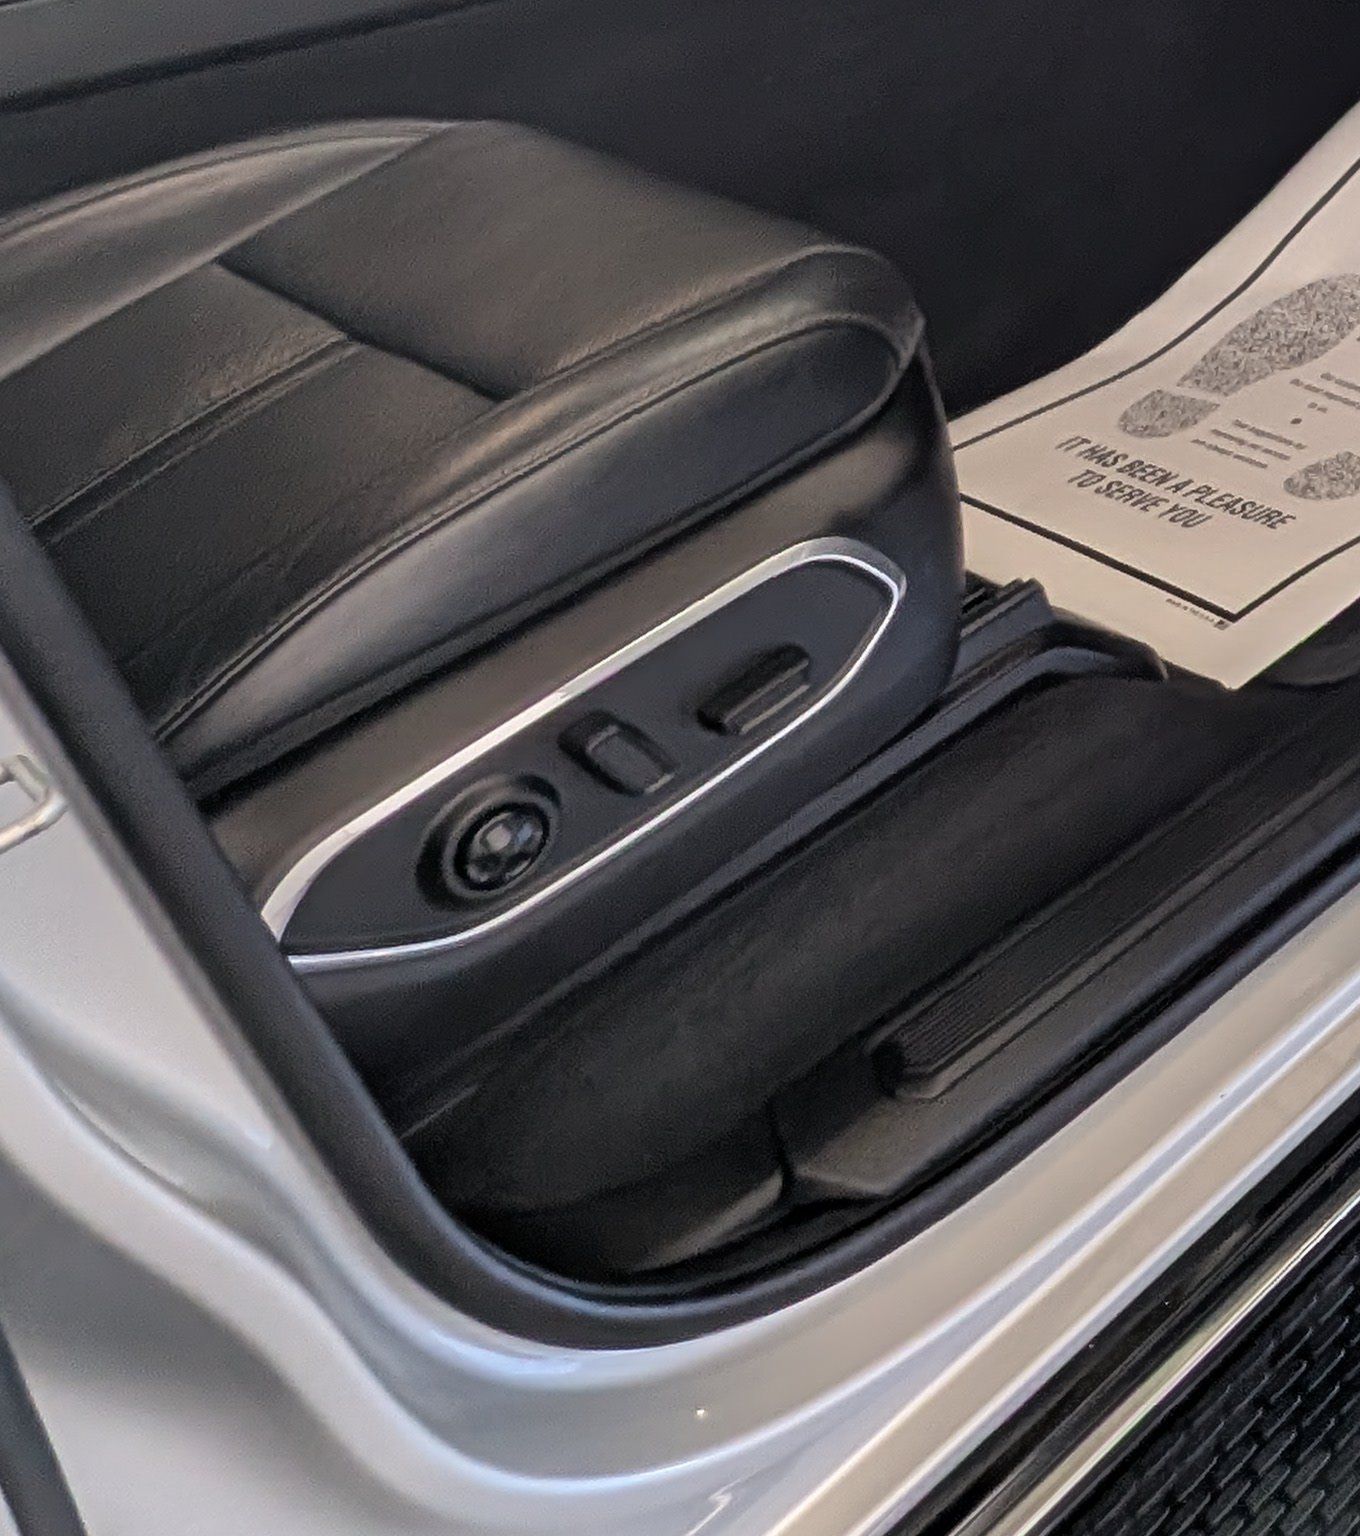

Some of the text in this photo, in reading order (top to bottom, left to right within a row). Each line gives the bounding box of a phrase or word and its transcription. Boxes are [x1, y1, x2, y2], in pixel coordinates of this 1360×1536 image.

[1055, 435, 1297, 530] IT HAS BEEN A PLEASURE
[1067, 468, 1213, 529] TO SERVE YOU
